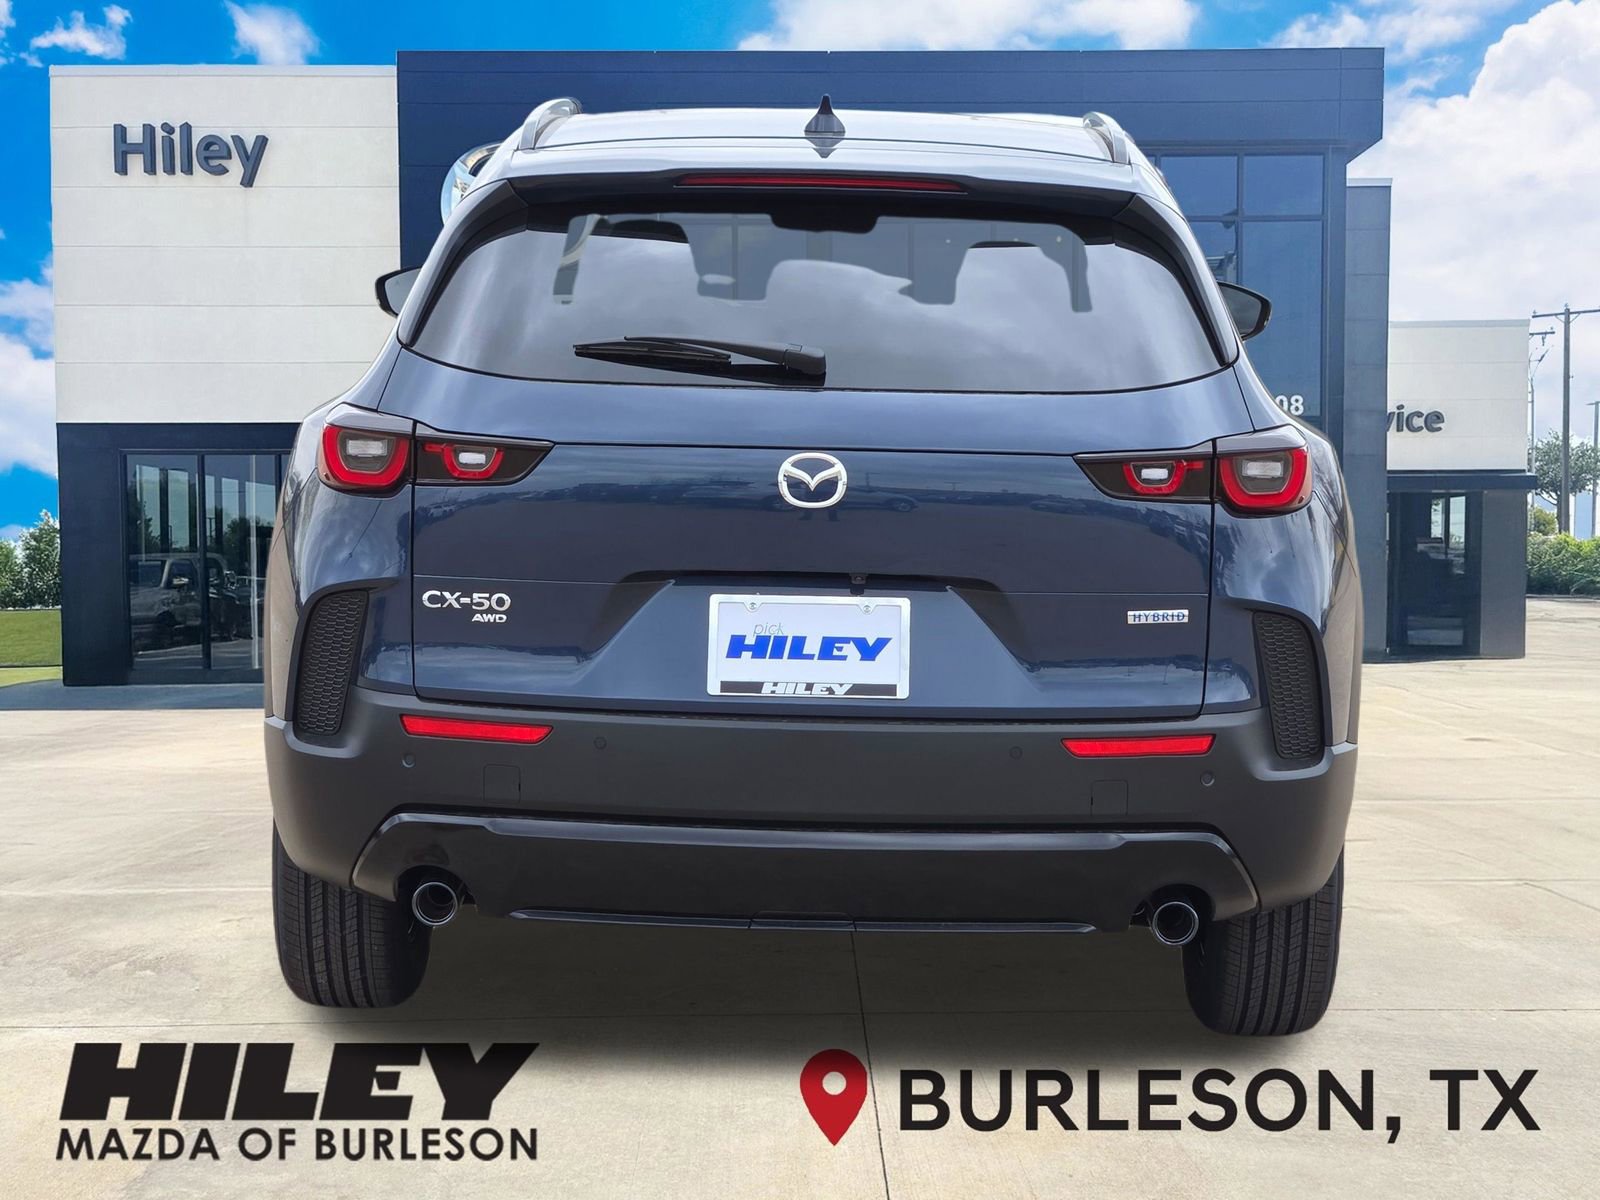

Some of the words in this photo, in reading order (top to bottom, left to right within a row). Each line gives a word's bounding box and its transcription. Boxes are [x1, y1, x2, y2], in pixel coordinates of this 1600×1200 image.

[113, 121, 269, 188] Hiley
[422, 590, 511, 611] CX-50
[471, 613, 507, 623] AWD
[1132, 611, 1185, 622] HYBRID
[753, 622, 784, 638] pick
[726, 634, 893, 661] HILEY
[761, 682, 854, 695] HILEY
